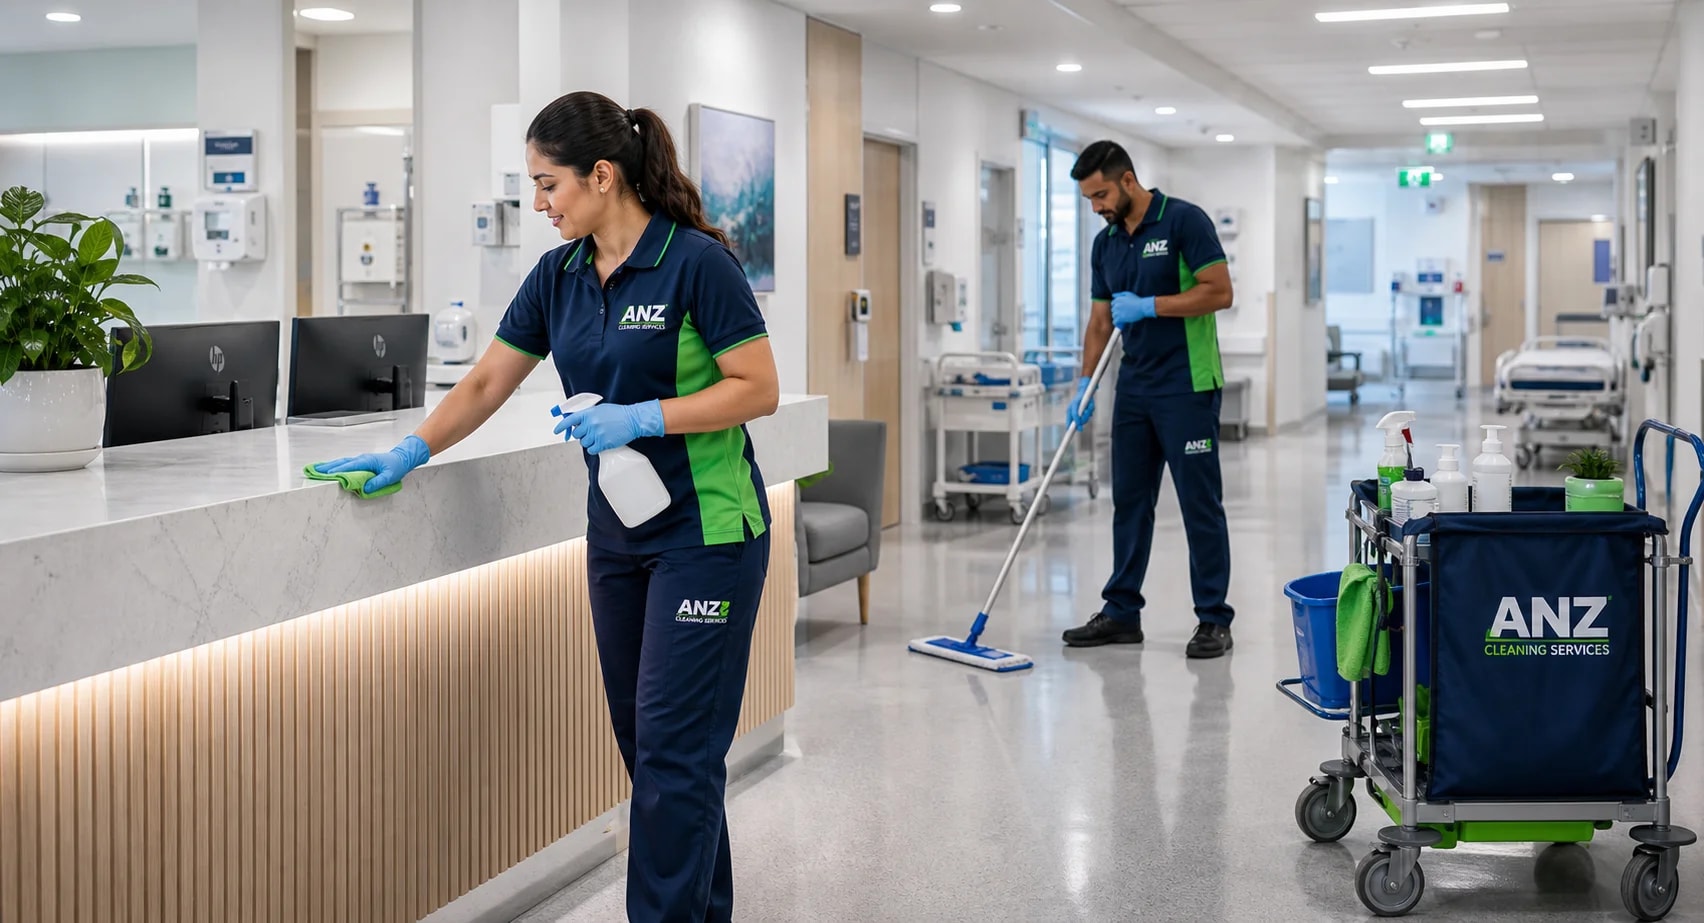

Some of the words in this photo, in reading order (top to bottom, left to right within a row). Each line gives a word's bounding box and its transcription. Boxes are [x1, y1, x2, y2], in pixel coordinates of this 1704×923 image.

[1143, 239, 1169, 254] ANZ
[620, 304, 666, 322] ANZ
[209, 345, 225, 373] hp
[1489, 596, 1609, 638] ANZ
[1484, 644, 1547, 656] CLEANING
[1550, 644, 1610, 656] SERVICES
